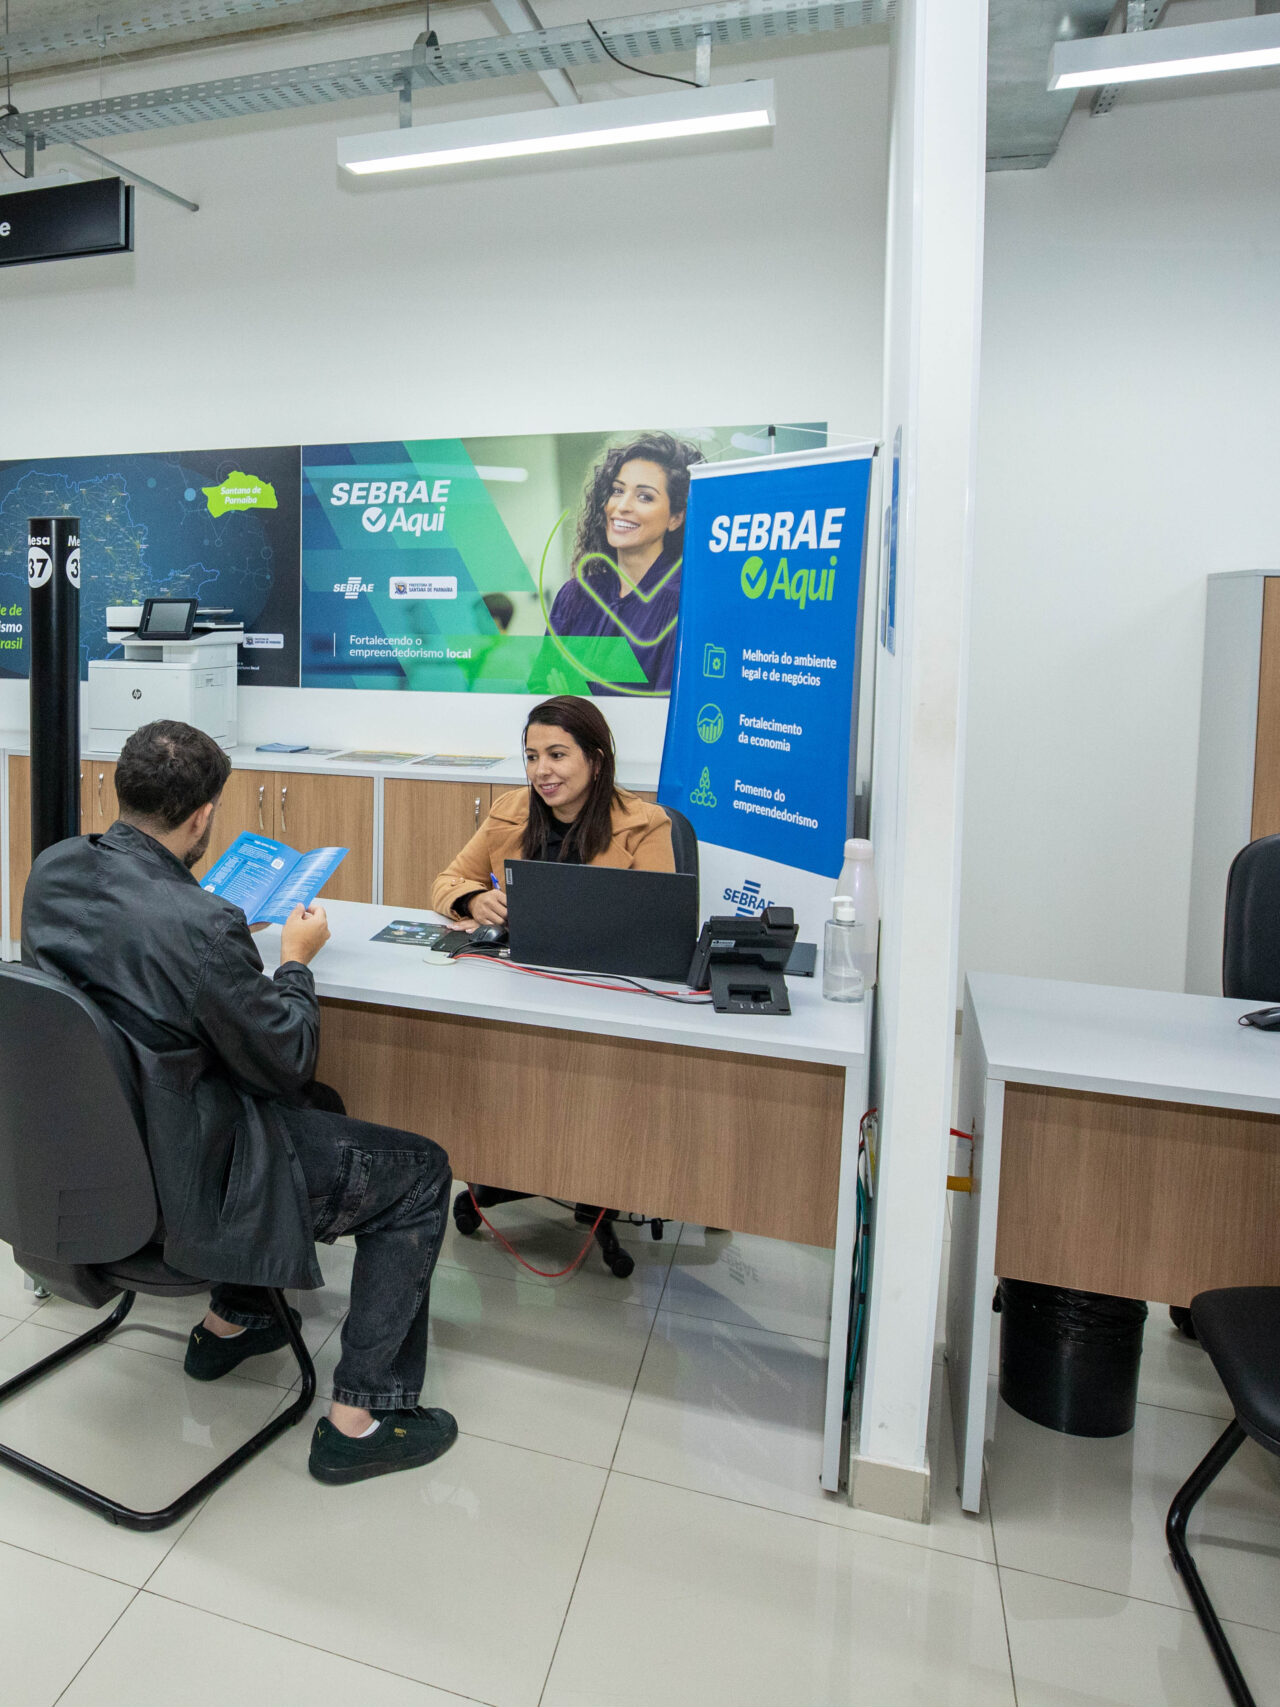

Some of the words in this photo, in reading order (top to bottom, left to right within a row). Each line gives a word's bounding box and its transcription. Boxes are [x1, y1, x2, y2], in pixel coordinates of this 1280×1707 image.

[221, 486, 251, 495] Santana
[252, 485, 262, 494] de
[330, 480, 451, 506] SEBRAE
[387, 506, 446, 537] Aqui
[708, 507, 846, 553] SEBRAE
[68, 535, 80, 547] Me
[29, 558, 49, 578] 37
[71, 558, 80, 578] 3
[333, 583, 374, 592] SEBRAE
[768, 555, 838, 610] Aqui
[9, 603, 23, 616] de
[349, 634, 413, 646] Fortalecendo
[415, 637, 423, 646] o
[349, 648, 444, 658] empreendedorismo
[446, 648, 472, 659] local
[742, 648, 780, 664] Melhoria
[781, 652, 793, 665] do
[794, 654, 838, 669] ambiente
[742, 665, 762, 681] legal
[762, 670, 768, 680] e
[769, 668, 780, 681] de
[782, 671, 821, 686] negócios
[739, 714, 802, 735] Fortalecimento
[738, 731, 749, 744] da
[750, 735, 791, 752] economia
[734, 779, 773, 799] Fomento
[774, 788, 786, 802] do
[733, 800, 818, 829] empreendedorismo
